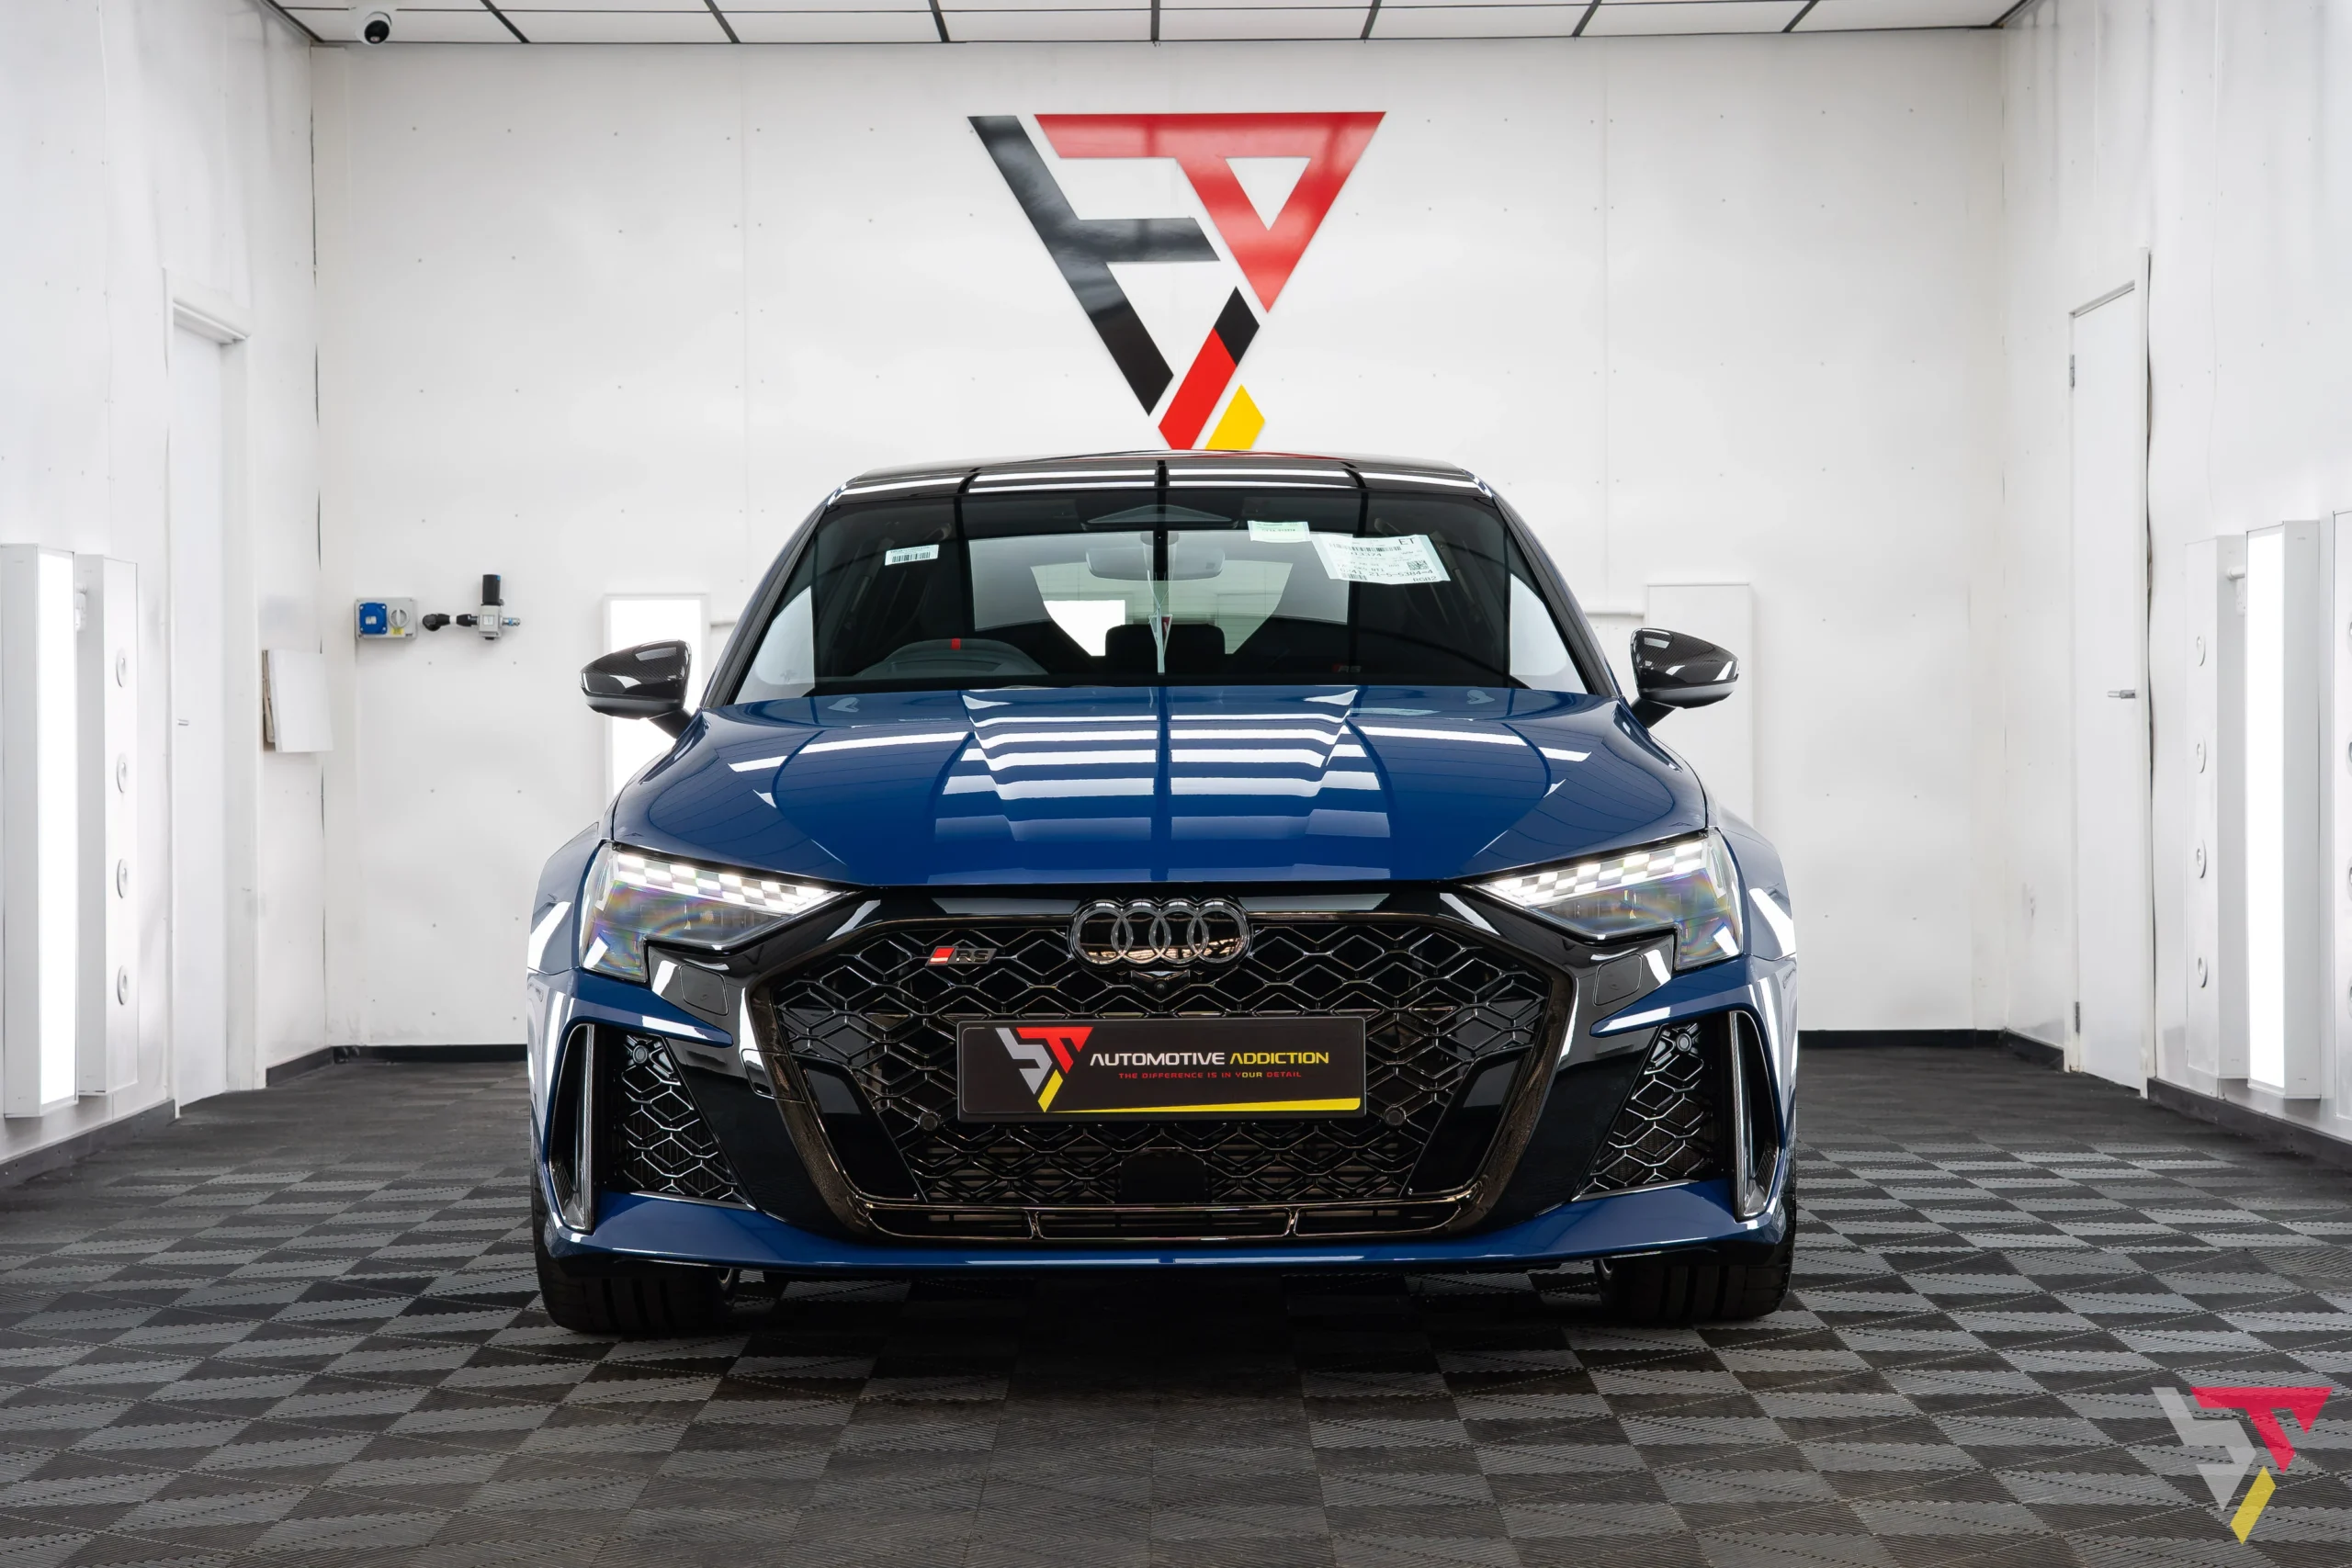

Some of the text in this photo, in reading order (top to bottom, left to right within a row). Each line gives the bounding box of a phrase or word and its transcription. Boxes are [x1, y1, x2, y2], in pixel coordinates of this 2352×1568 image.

[1398, 537, 1416, 546] ET
[956, 949, 989, 964] RS
[1090, 1052, 1329, 1066] AUTOMOTIVE ADDICTION
